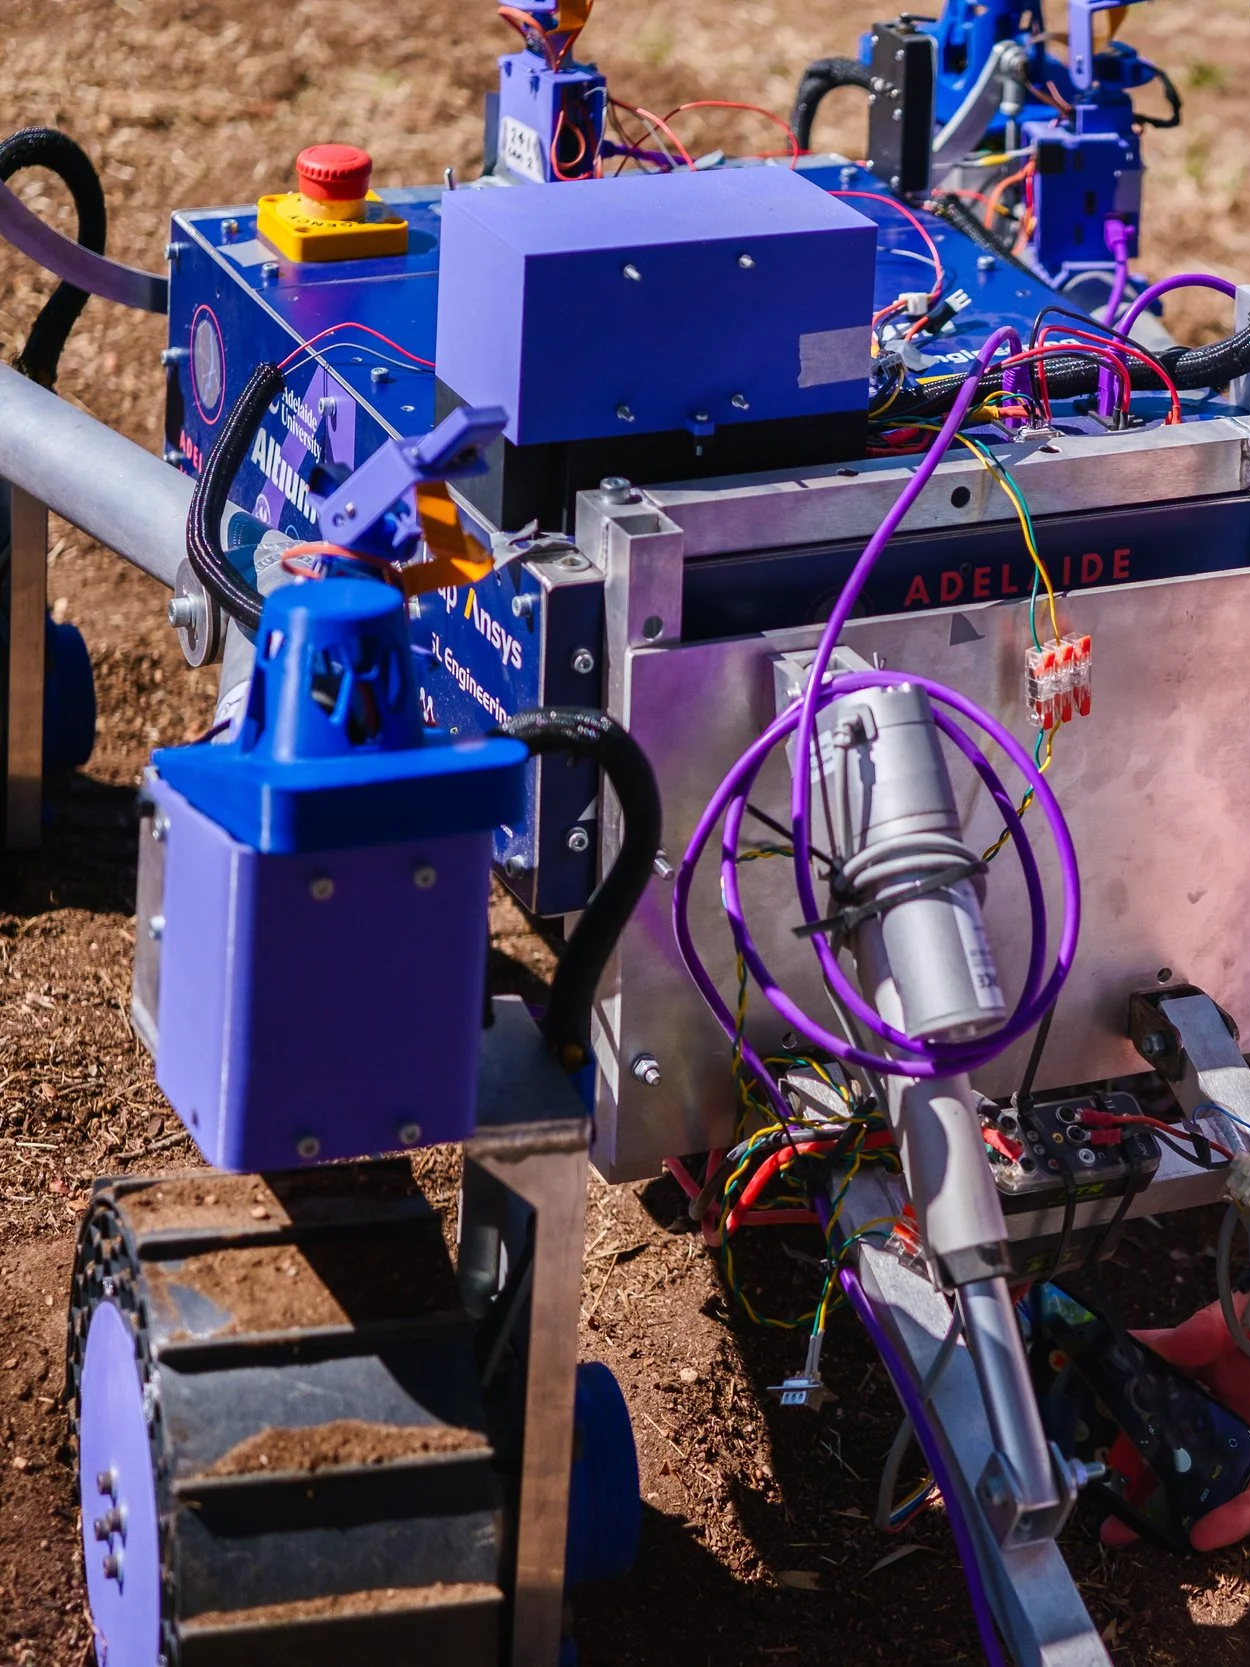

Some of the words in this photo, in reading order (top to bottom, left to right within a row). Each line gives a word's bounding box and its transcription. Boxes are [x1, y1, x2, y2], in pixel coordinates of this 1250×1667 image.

[281, 403, 322, 464] University
[282, 386, 318, 433] Adelaide
[463, 587, 523, 670] Ansys
[444, 647, 512, 727] Engineerin
